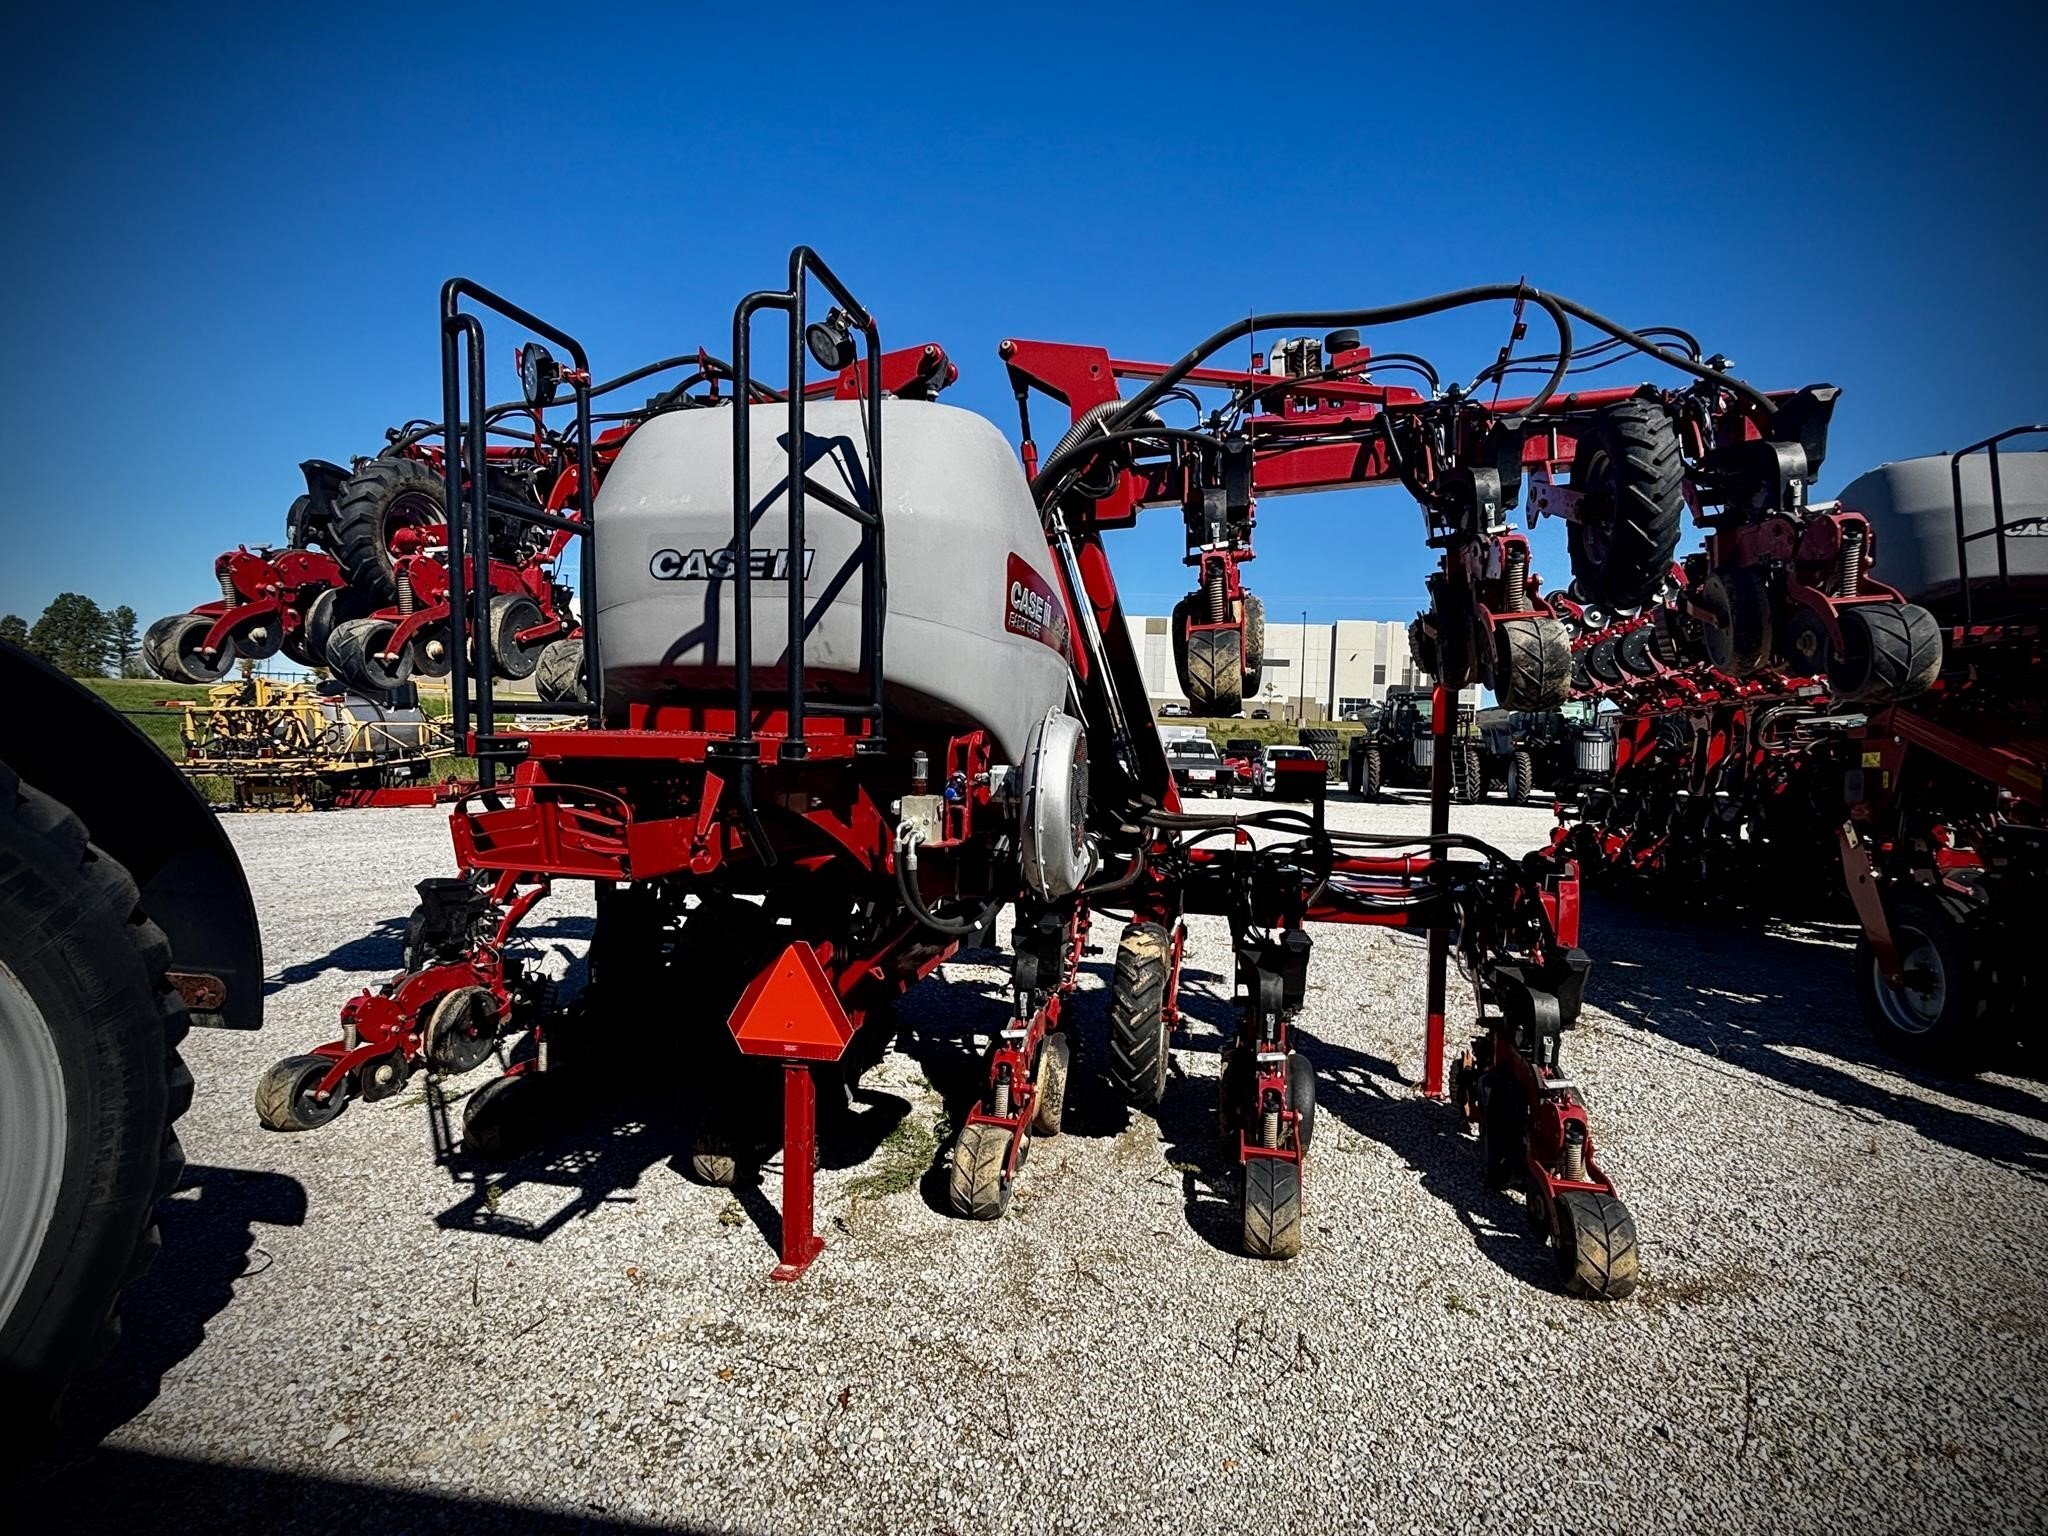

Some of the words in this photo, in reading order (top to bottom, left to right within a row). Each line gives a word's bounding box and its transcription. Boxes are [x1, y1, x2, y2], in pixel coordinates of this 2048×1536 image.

[650, 549, 770, 580] CASE
[772, 549, 815, 580] H
[1011, 581, 1044, 623] CASE
